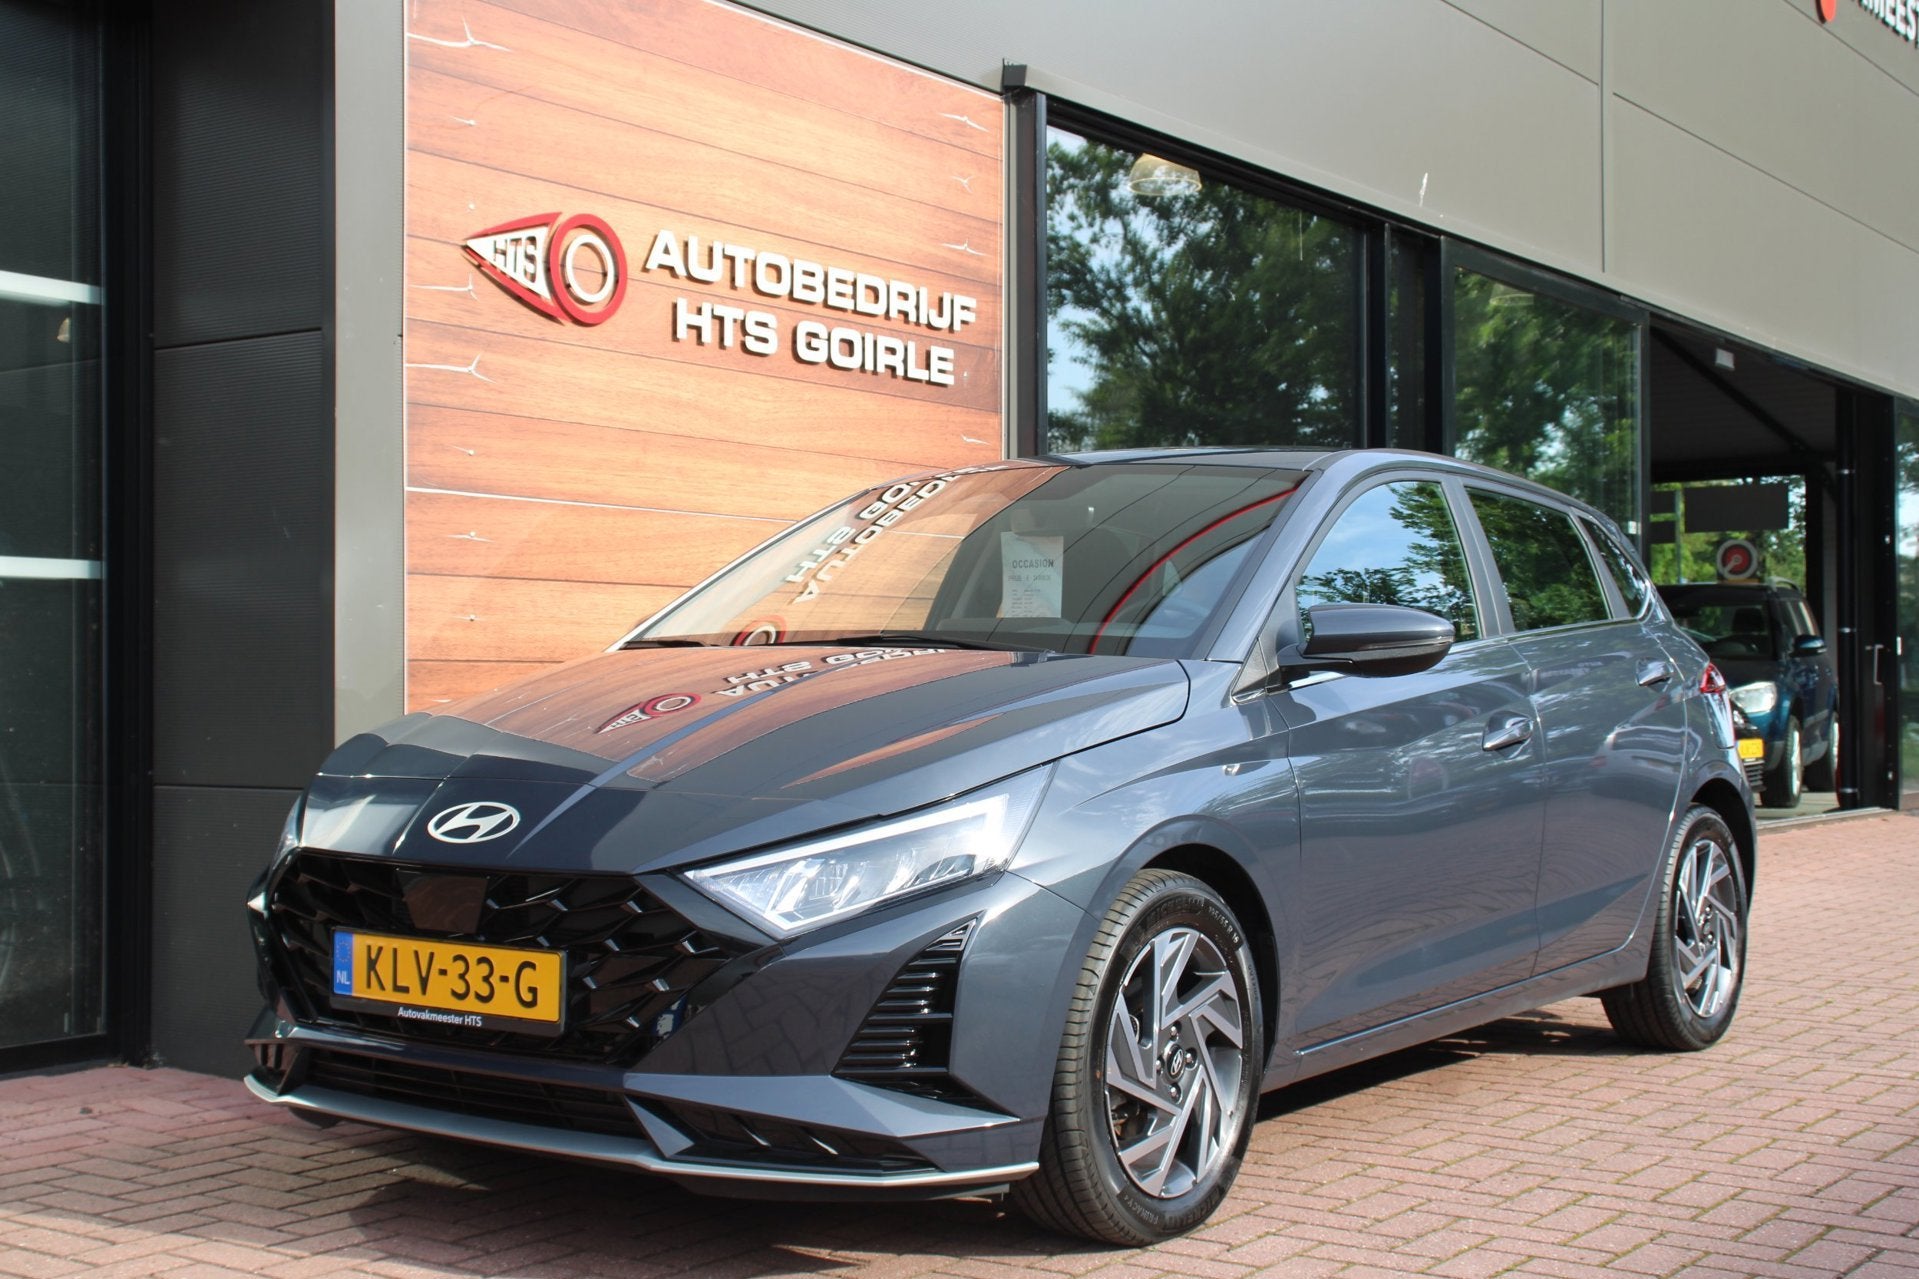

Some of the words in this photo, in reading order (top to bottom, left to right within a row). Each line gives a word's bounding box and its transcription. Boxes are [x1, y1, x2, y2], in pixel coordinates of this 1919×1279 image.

[493, 235, 538, 284] HTS
[645, 229, 977, 331] AUTOBEDRIJF
[675, 297, 779, 356] HTS
[795, 320, 955, 386] GOIRLE
[1011, 559, 1055, 569] OCCASION
[336, 970, 351, 985] NL
[366, 944, 539, 1009] KLV-33-G
[397, 1007, 463, 1026] Autovakmeester
[464, 1015, 482, 1027] HTS
